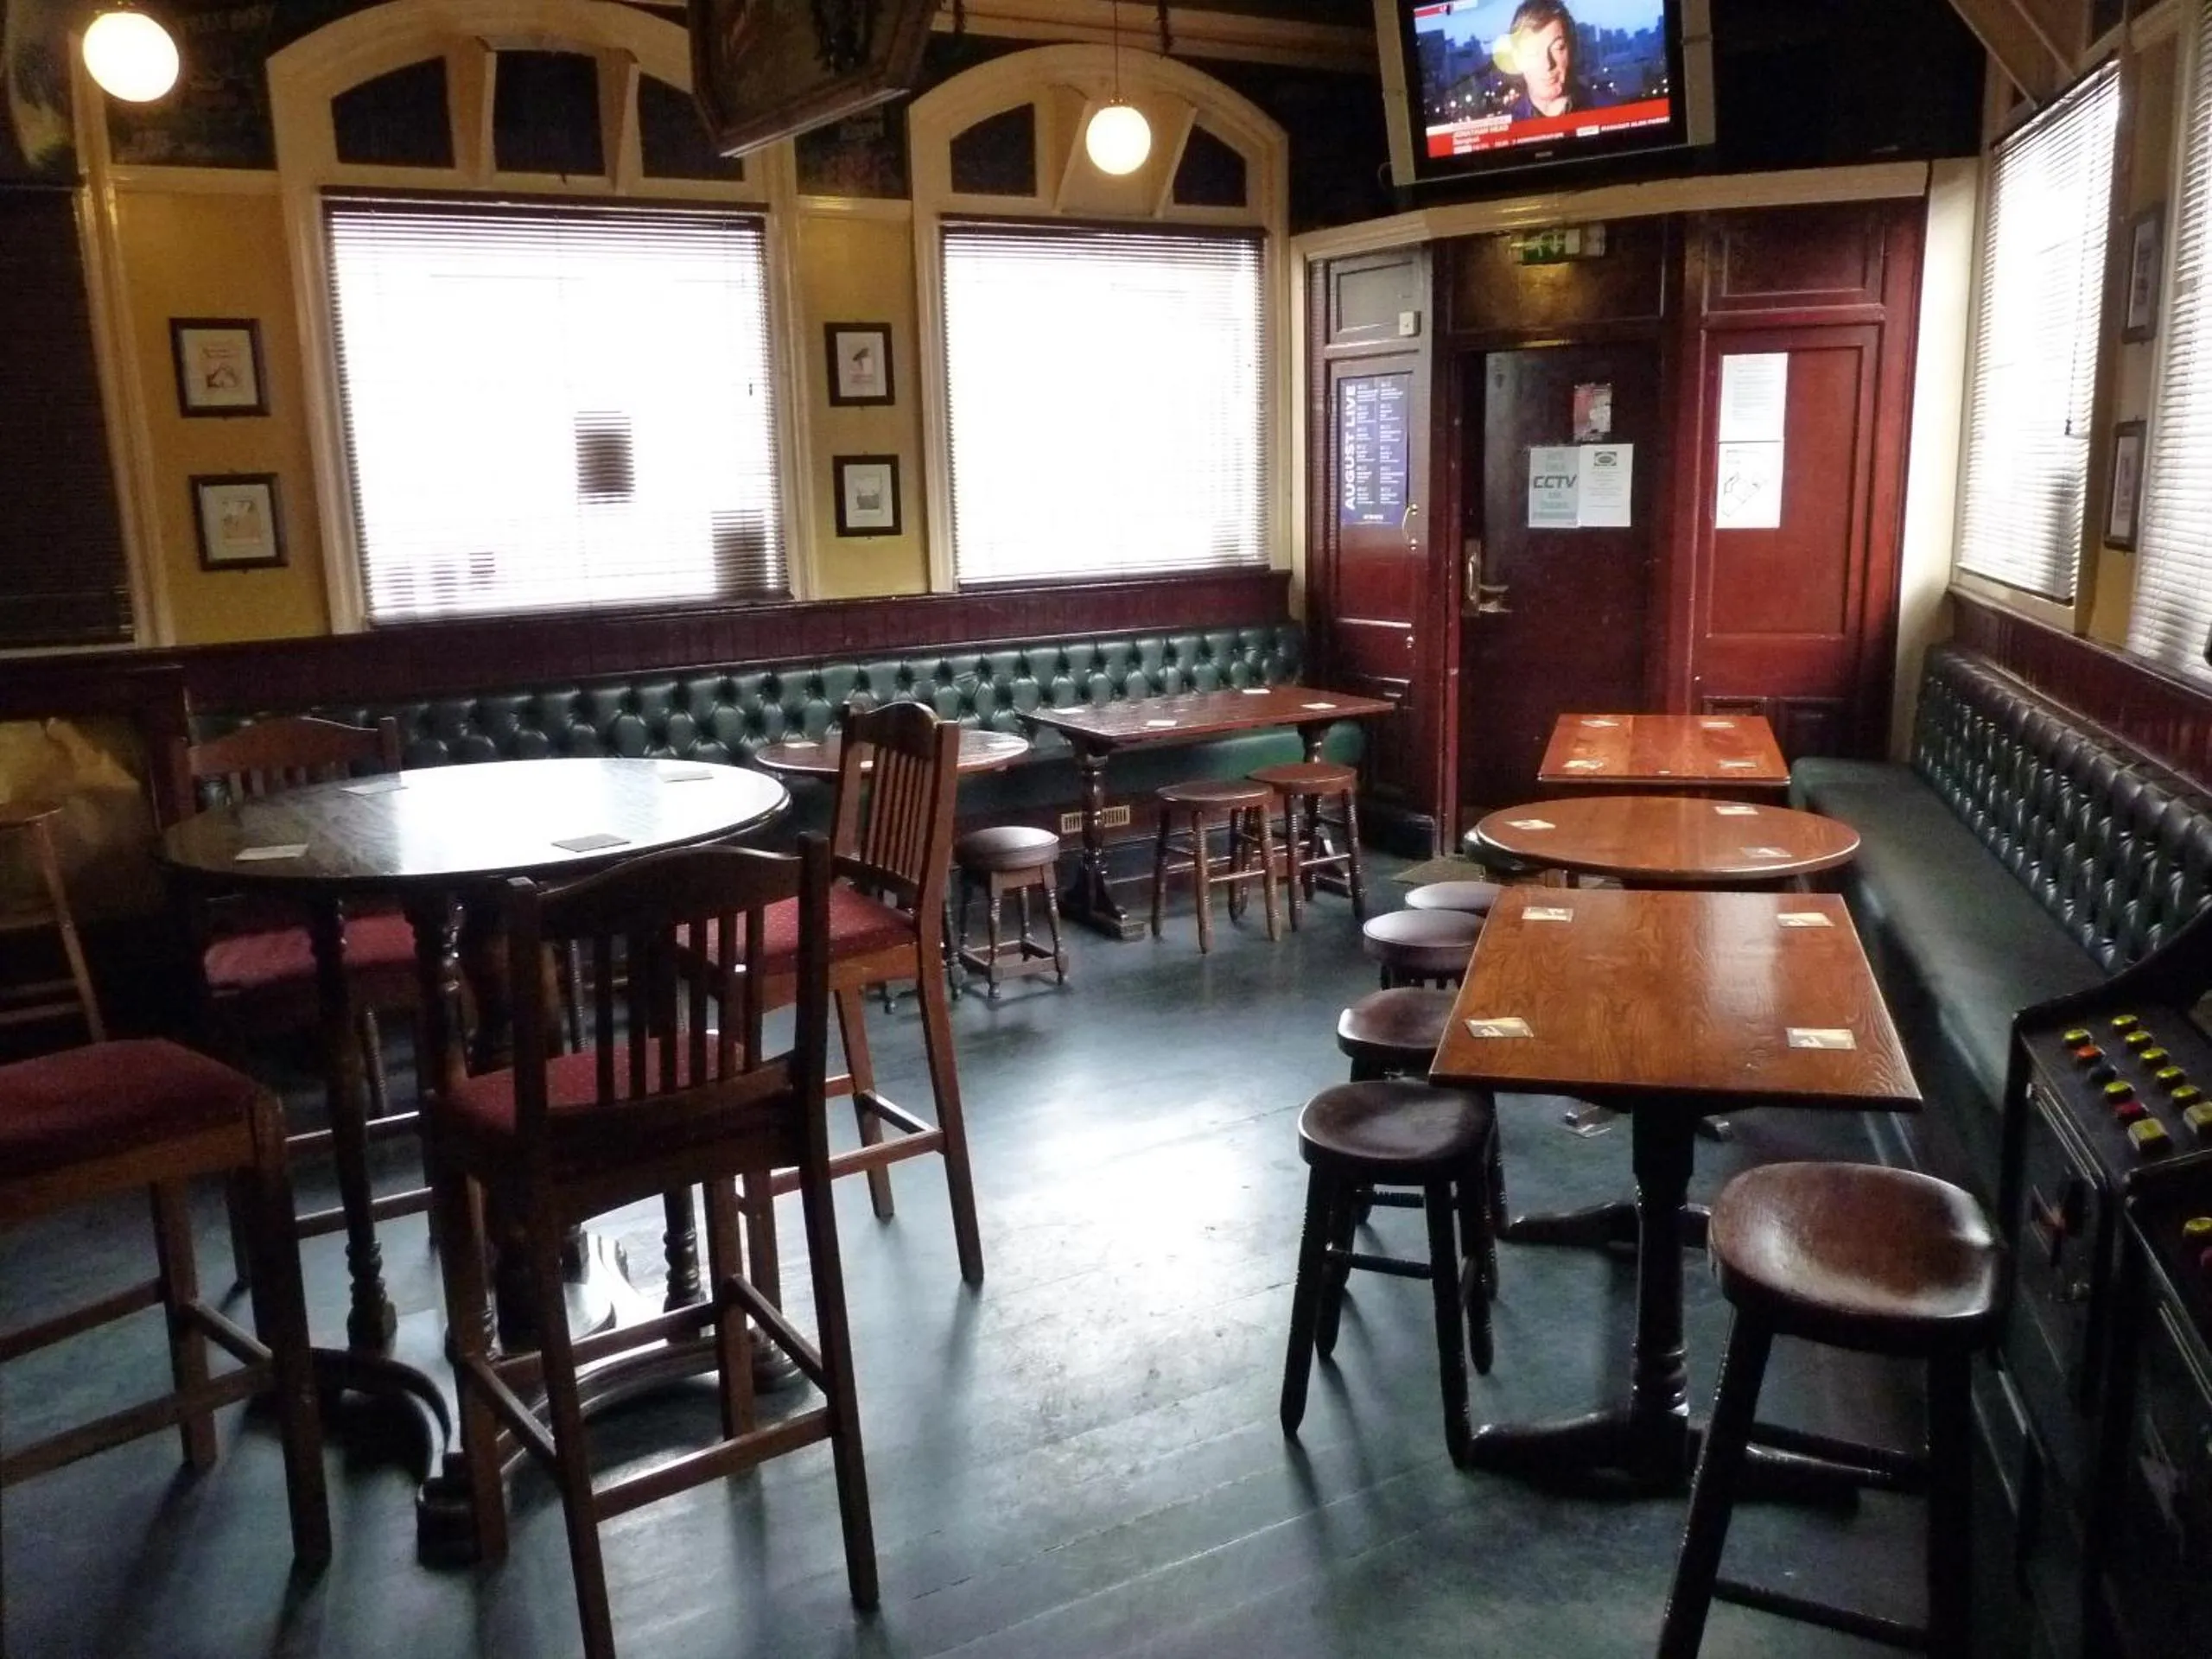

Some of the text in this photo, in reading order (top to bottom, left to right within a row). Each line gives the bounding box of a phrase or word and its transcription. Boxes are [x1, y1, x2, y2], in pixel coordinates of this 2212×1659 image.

[1344, 385, 1357, 510] AUGUST LIVE
[1534, 475, 1577, 488] CCTV
